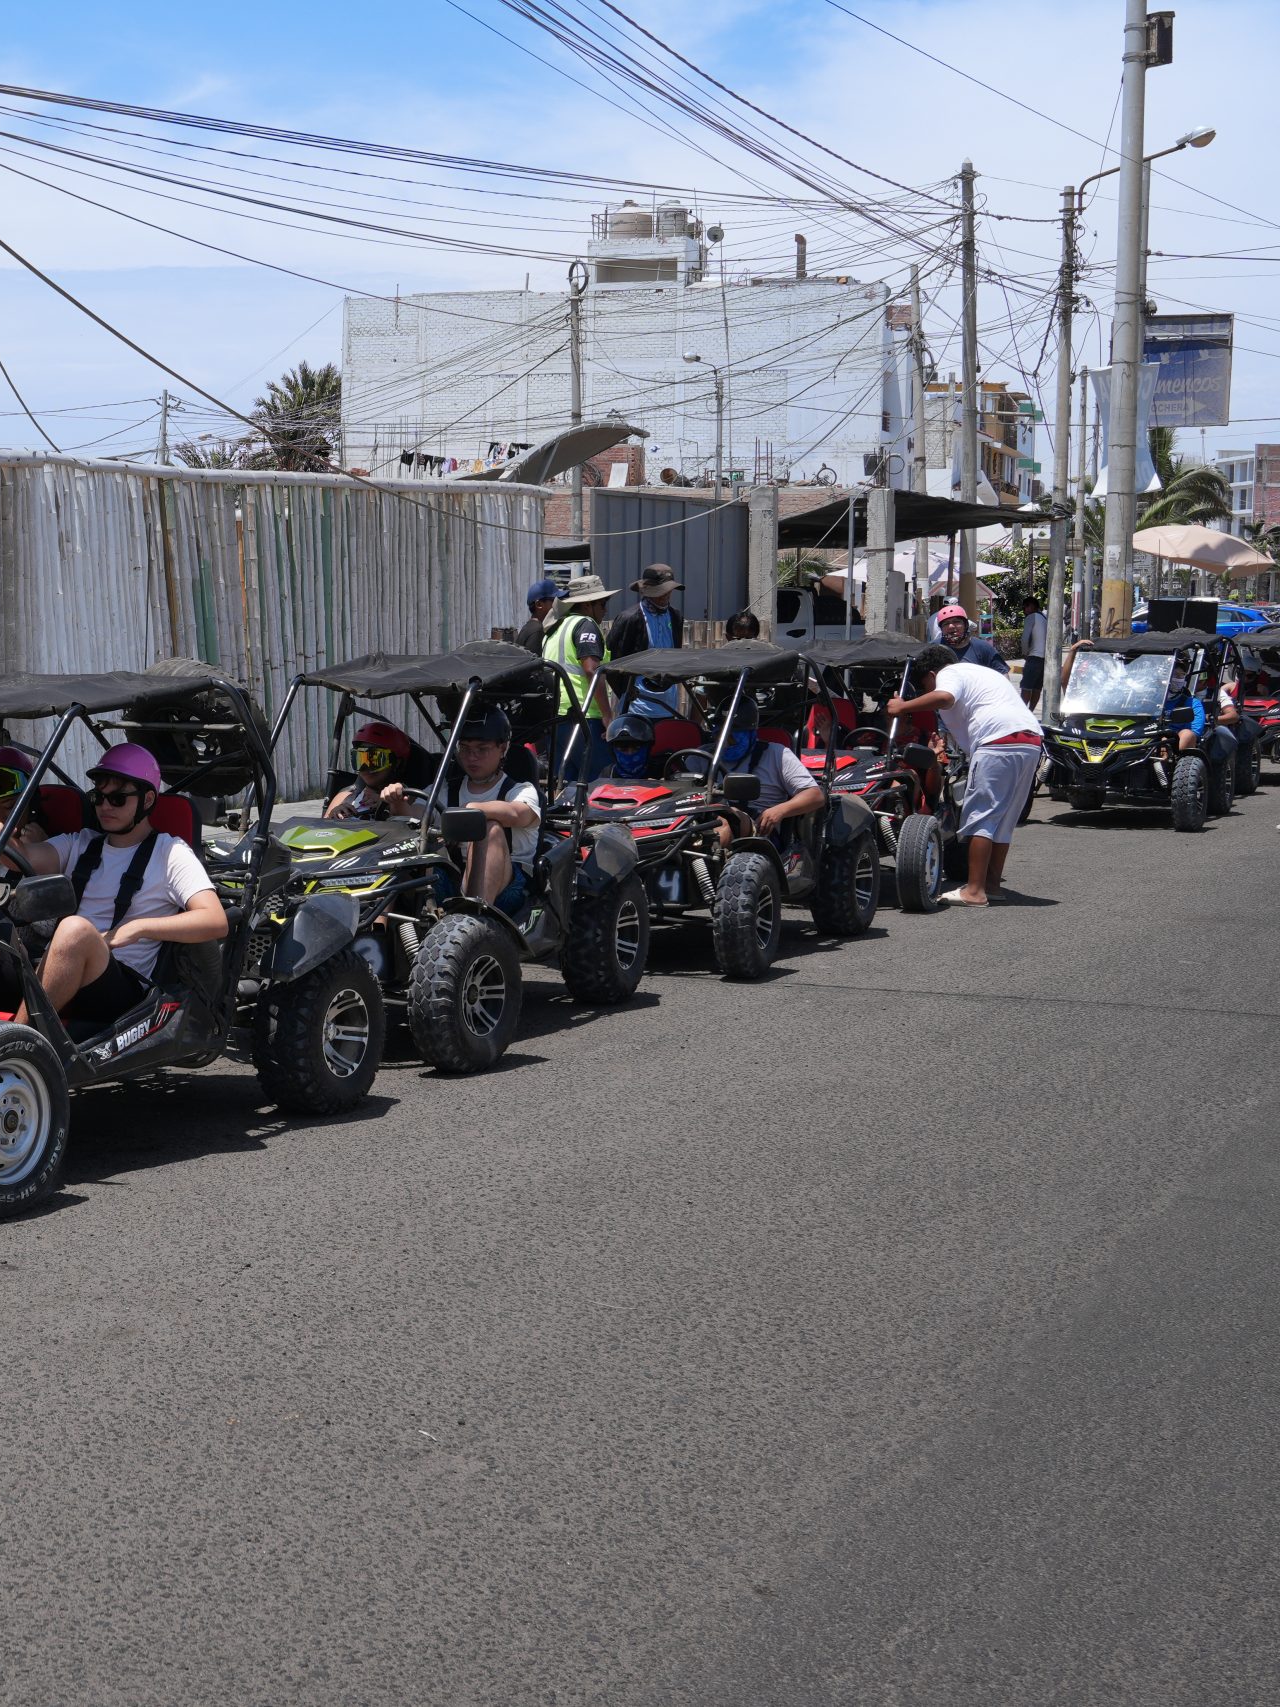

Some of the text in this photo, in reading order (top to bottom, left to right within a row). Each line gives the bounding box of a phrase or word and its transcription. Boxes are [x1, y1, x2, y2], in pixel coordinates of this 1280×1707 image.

[1153, 376, 1221, 394] mencos
[1150, 402, 1189, 413] OCHERA
[579, 632, 597, 641] FR
[659, 870, 680, 901] 4
[116, 1019, 151, 1051] BUGGY
[40, 1128, 65, 1184] EAGLE
